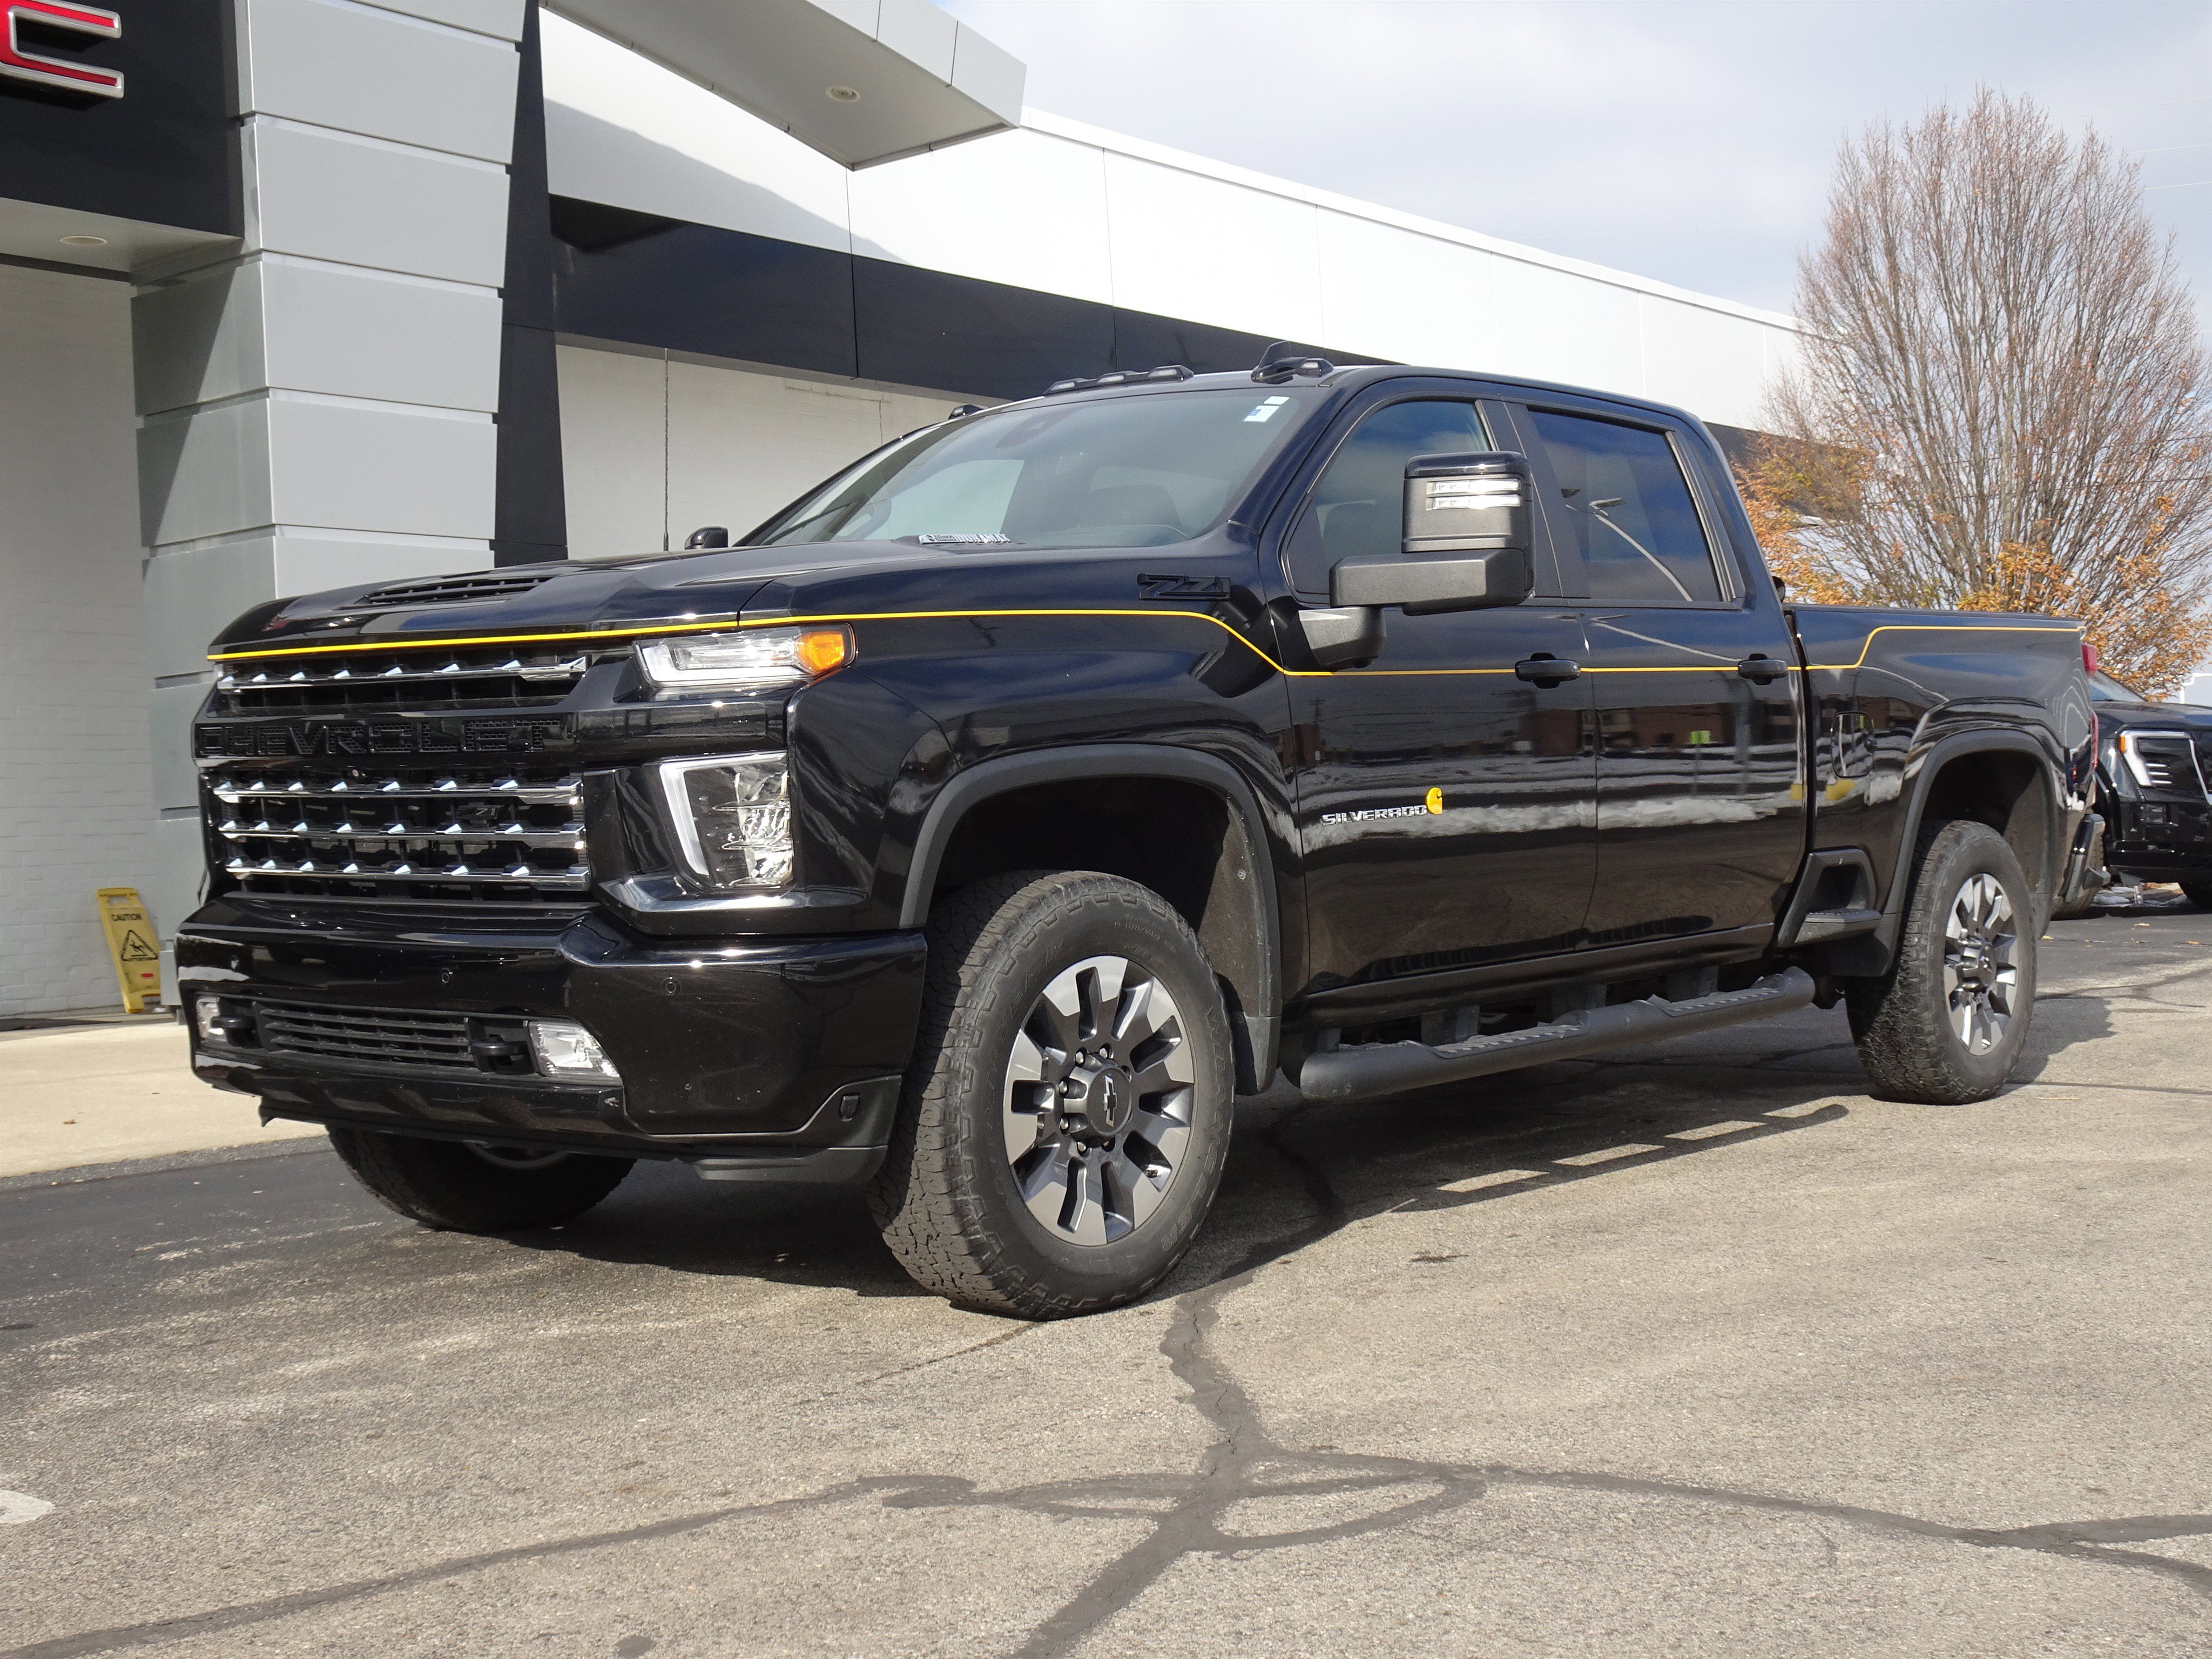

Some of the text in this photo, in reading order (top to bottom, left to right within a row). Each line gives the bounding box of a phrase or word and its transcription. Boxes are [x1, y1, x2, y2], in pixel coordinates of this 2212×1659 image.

[1137, 573, 1231, 601] Z71
[200, 720, 561, 755] CHEVROLET
[1322, 805, 1427, 825] SILVERADO
[111, 913, 142, 921] CAUTION
[1161, 1006, 1227, 1252] WRANGLER
